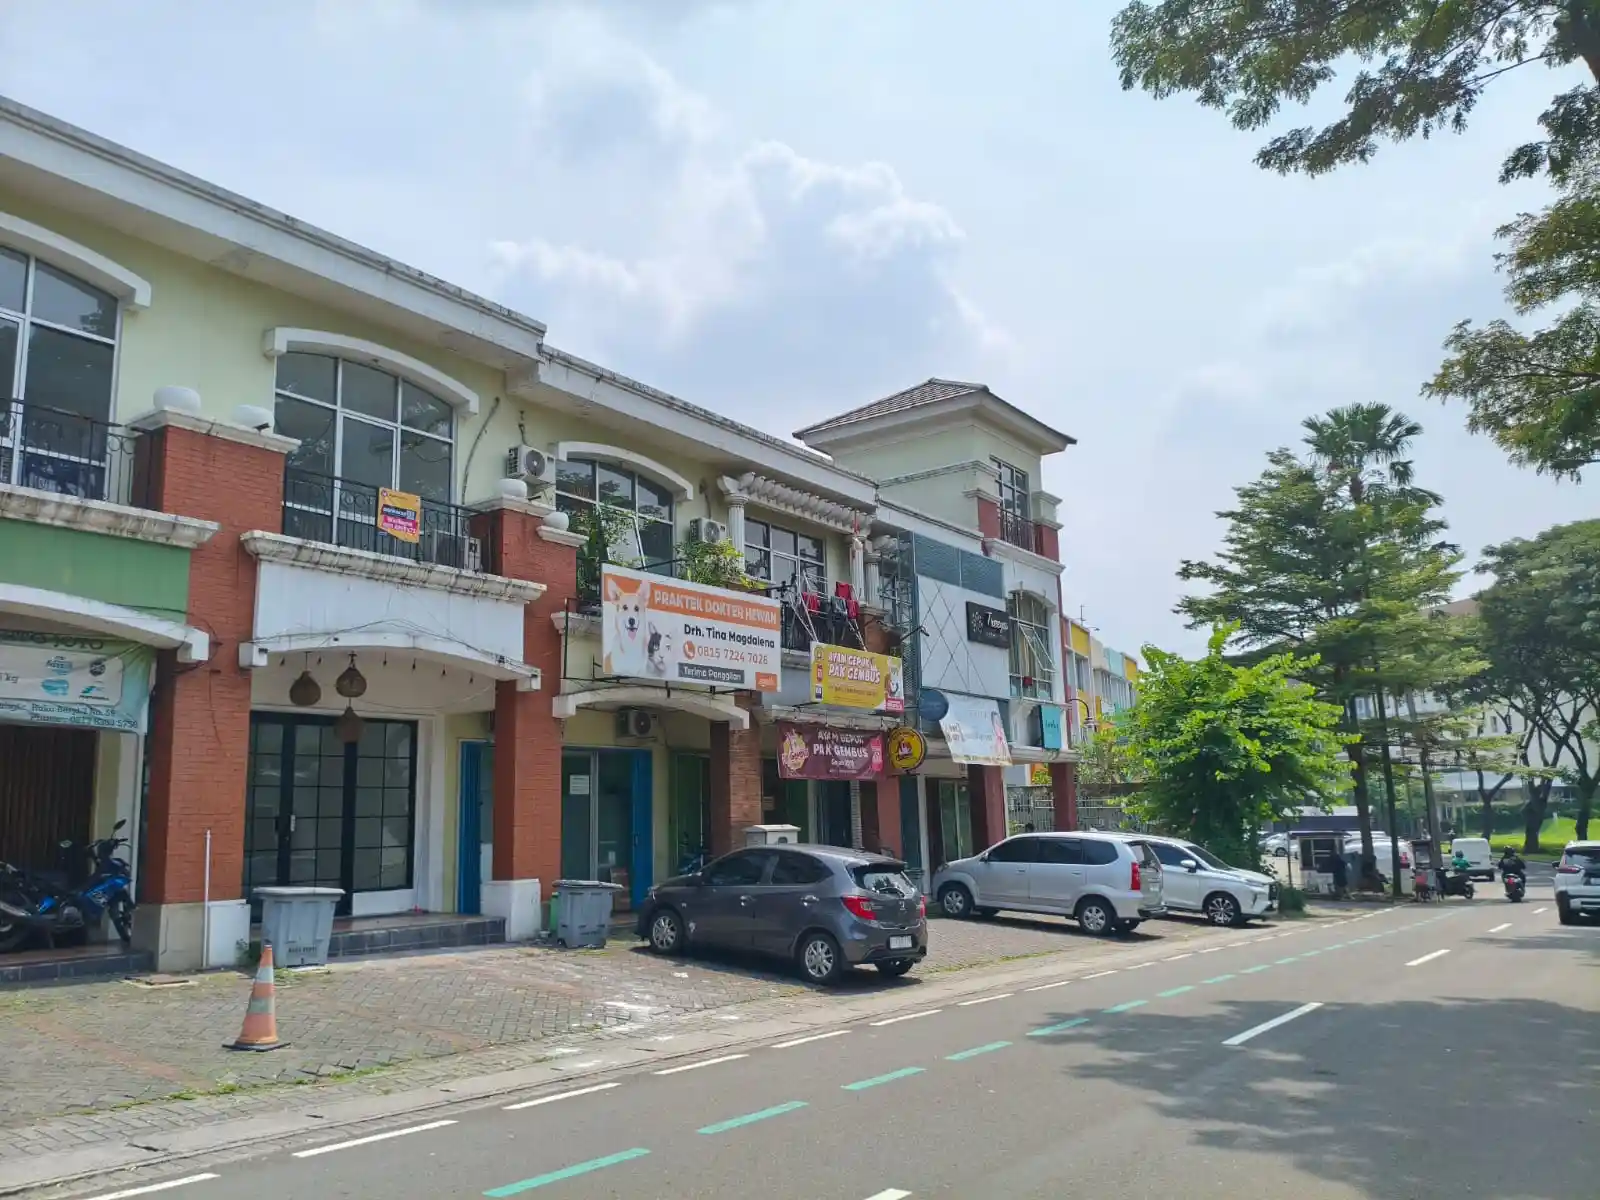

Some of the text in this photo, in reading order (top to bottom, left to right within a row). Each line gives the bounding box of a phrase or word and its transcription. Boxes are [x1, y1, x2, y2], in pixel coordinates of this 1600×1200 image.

[654, 590, 776, 625] PRAKTEK DOKTER HEWAN
[684, 623, 775, 648] Drh. Tina Magdalena
[697, 646, 720, 658] 0815
[724, 648, 745, 662] 7224
[684, 666, 707, 677] Terima
[828, 663, 846, 677] PAK
[848, 668, 881, 685] GEMBUS
[817, 730, 839, 741] AYAM
[813, 744, 832, 756] PAK
[833, 746, 869, 758] GEMBUS
